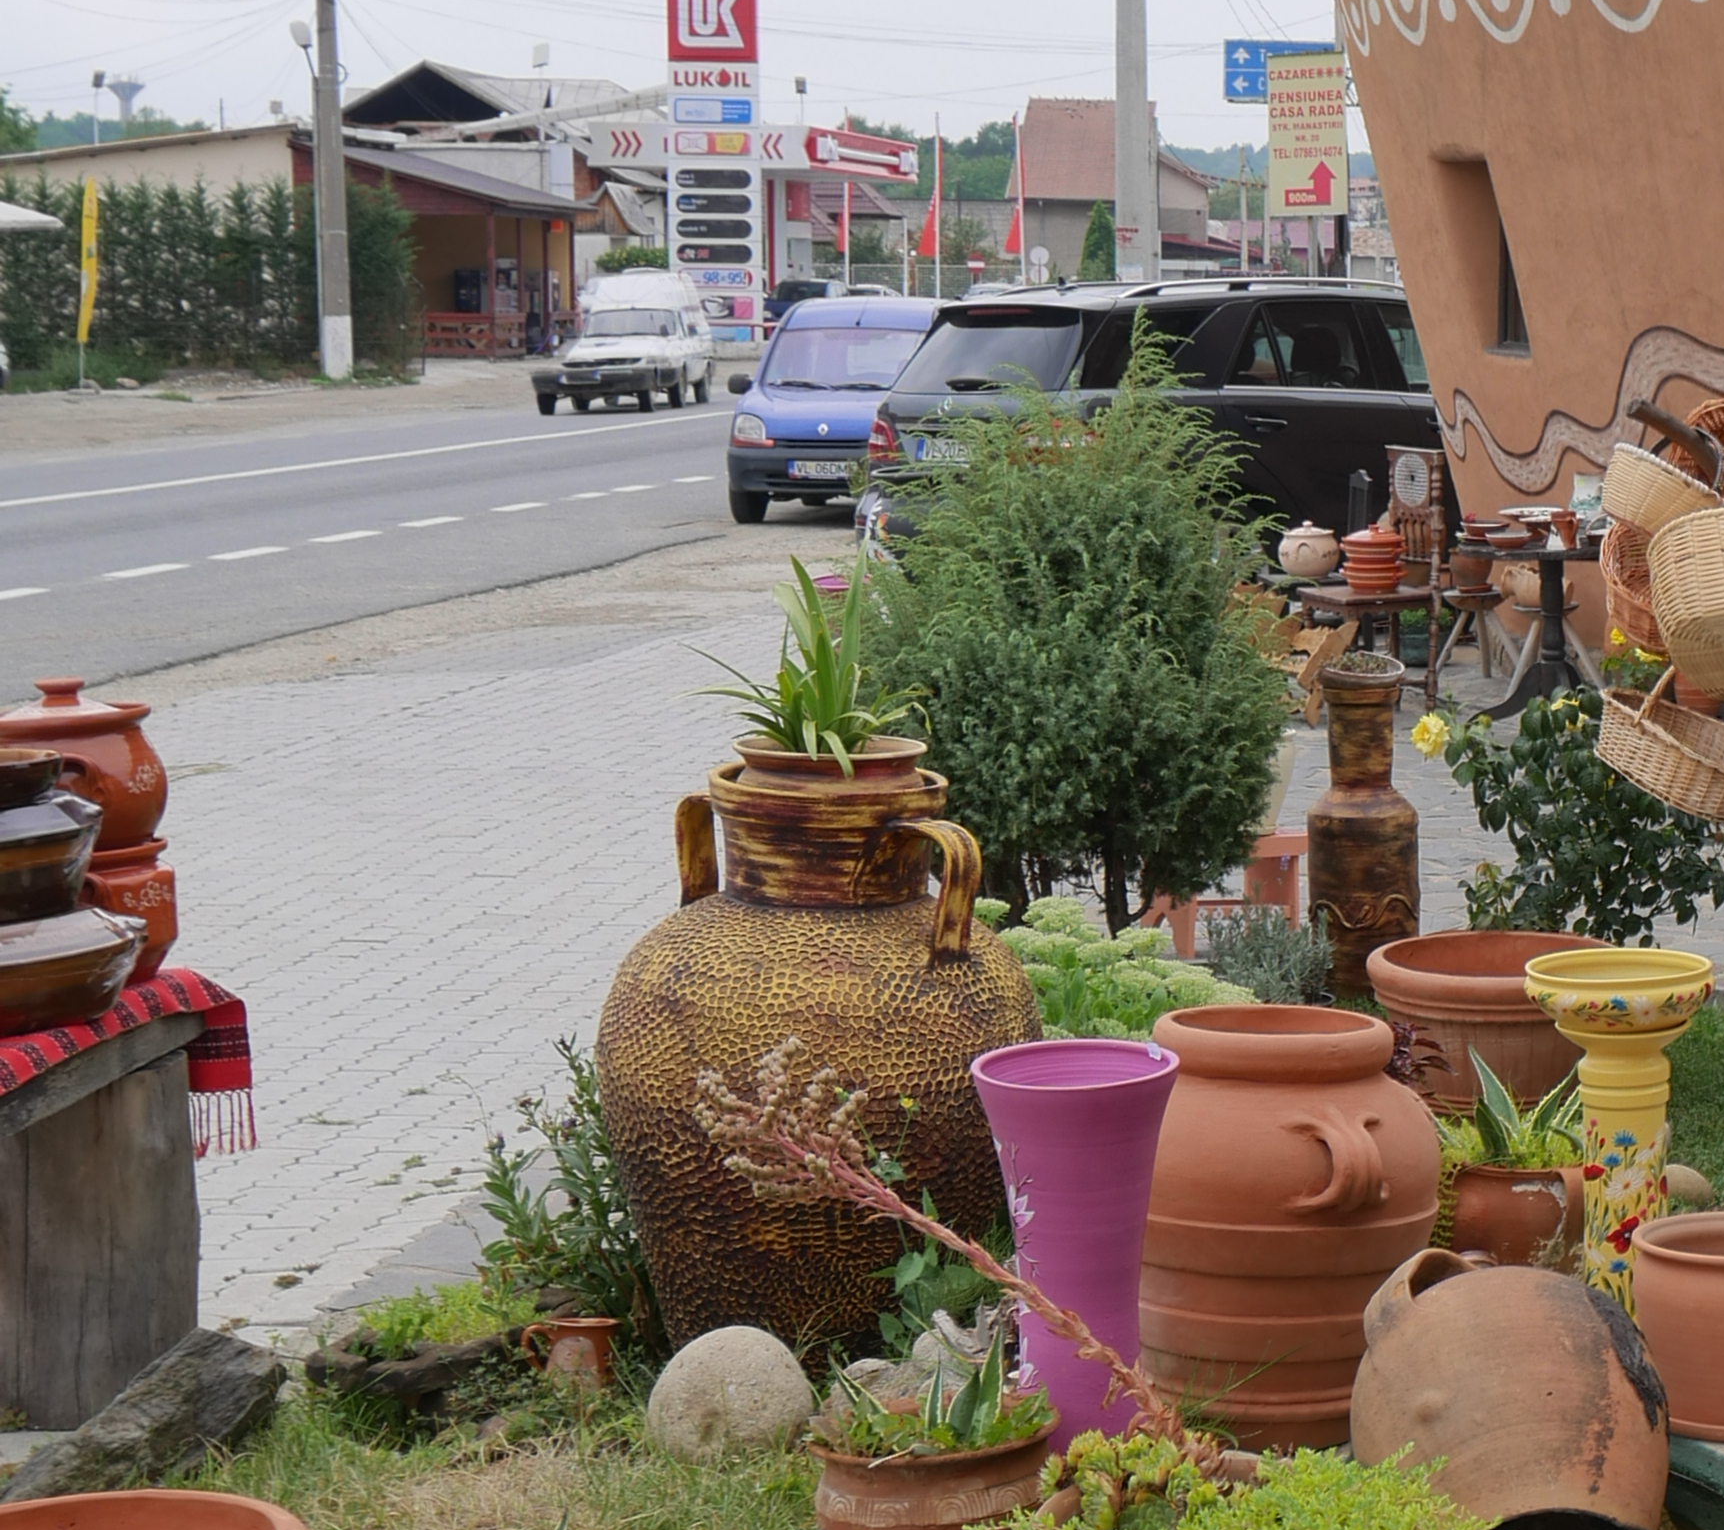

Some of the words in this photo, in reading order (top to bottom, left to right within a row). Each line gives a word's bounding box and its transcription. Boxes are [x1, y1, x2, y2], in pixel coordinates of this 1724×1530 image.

[673, 68, 751, 88] LUKOIL
[1270, 90, 1343, 104] PENSIUNEA
[1269, 106, 1305, 119] CASA
[1309, 104, 1345, 117] RADA
[1272, 123, 1291, 132] STR.
[1273, 148, 1291, 159] TEL:
[1288, 192, 1317, 204] 900m
[796, 462, 811, 475] VL
